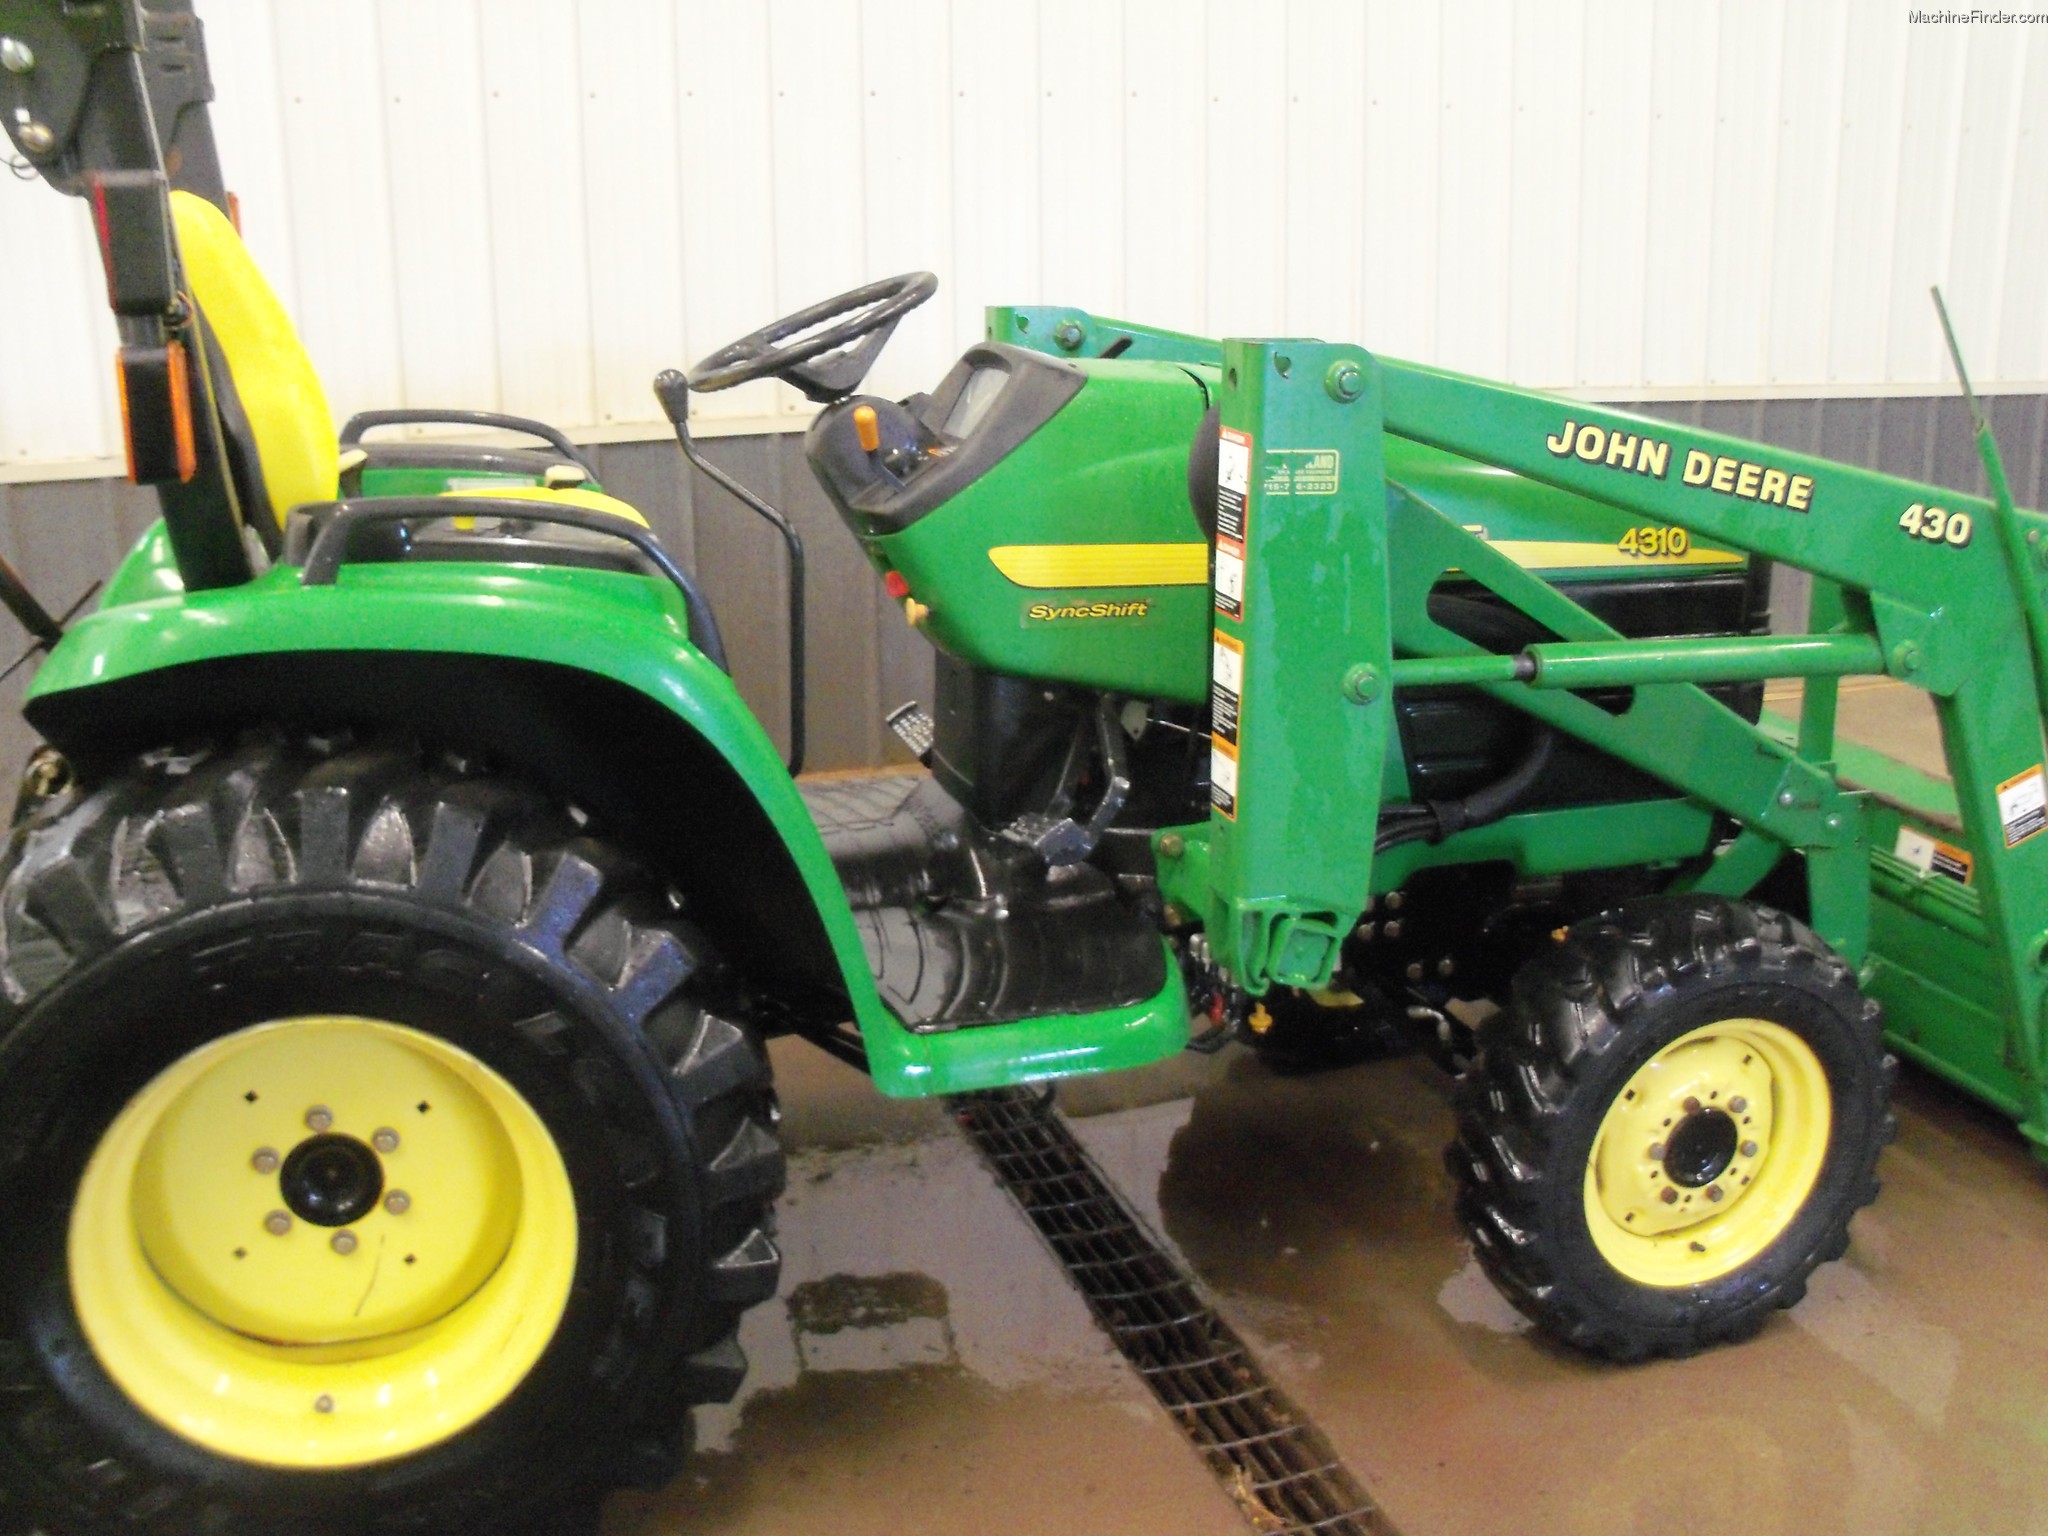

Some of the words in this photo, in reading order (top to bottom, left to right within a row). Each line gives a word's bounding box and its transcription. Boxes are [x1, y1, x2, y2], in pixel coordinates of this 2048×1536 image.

[1546, 420, 1670, 479] JOHN
[1682, 448, 1814, 511] DEERE
[1618, 526, 1689, 556] 4310
[1898, 503, 1972, 548] 430
[1029, 602, 1148, 621] SyncShift
